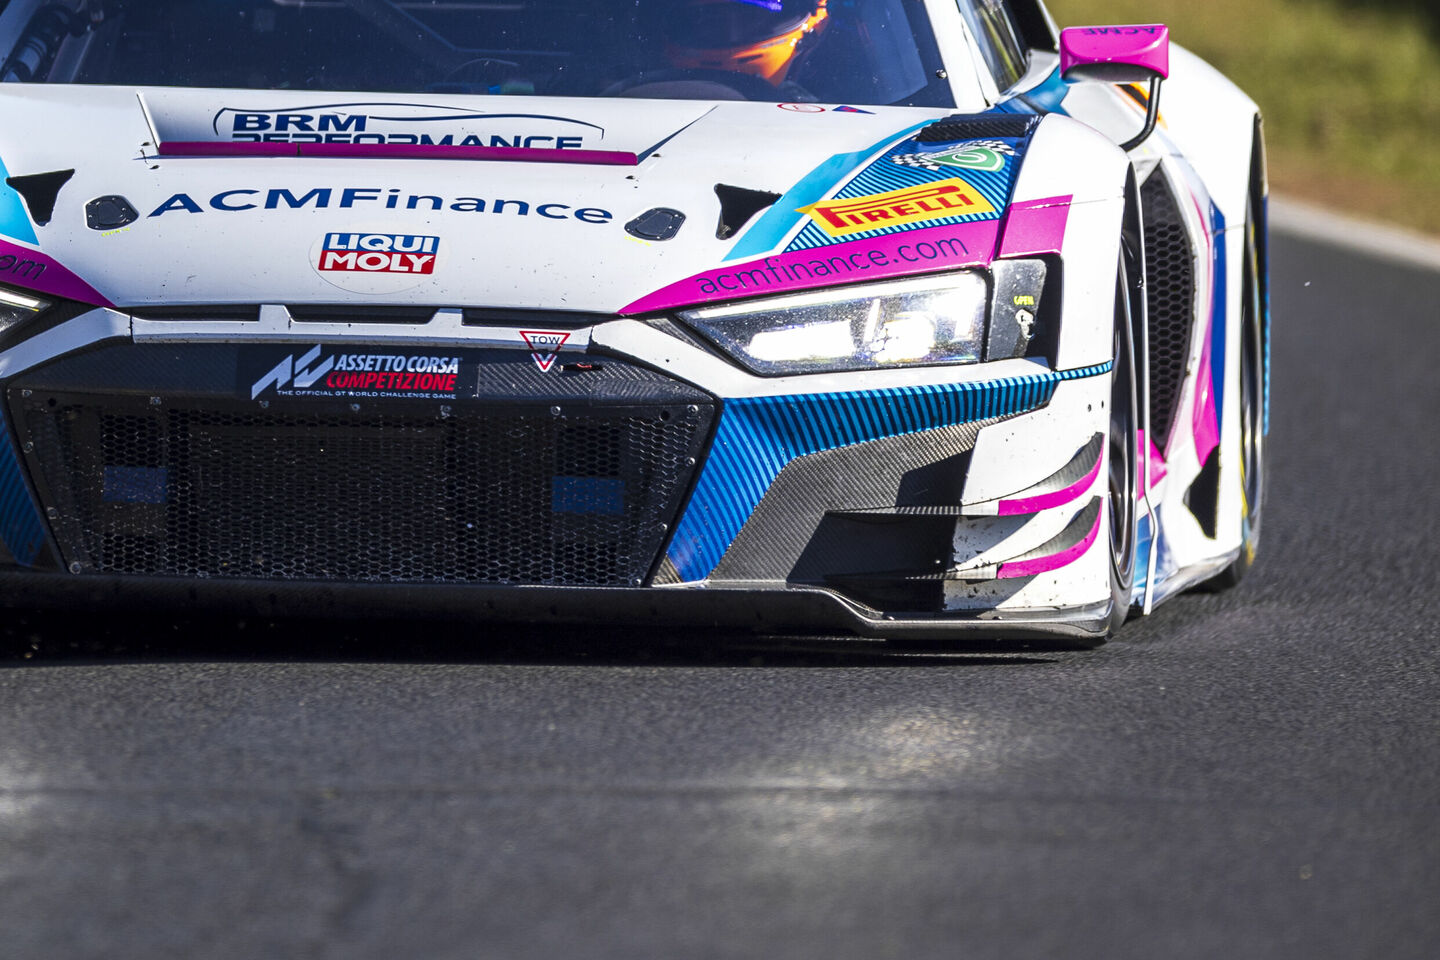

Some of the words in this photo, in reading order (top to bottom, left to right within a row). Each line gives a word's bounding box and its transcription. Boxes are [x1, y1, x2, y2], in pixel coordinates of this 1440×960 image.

[233, 113, 368, 132] BRM
[147, 187, 613, 225] ACMFinance
[822, 184, 975, 229] PIRELLI
[327, 234, 436, 254] LIQUI
[324, 253, 433, 274] MOLY
[699, 235, 969, 295] acmfinance.com
[531, 335, 561, 345] TOW
[333, 354, 407, 373] ASSETTO
[406, 356, 459, 375] CORSA
[326, 371, 457, 391] COMPETIZIONE
[379, 391, 431, 399] CHALLENGE
